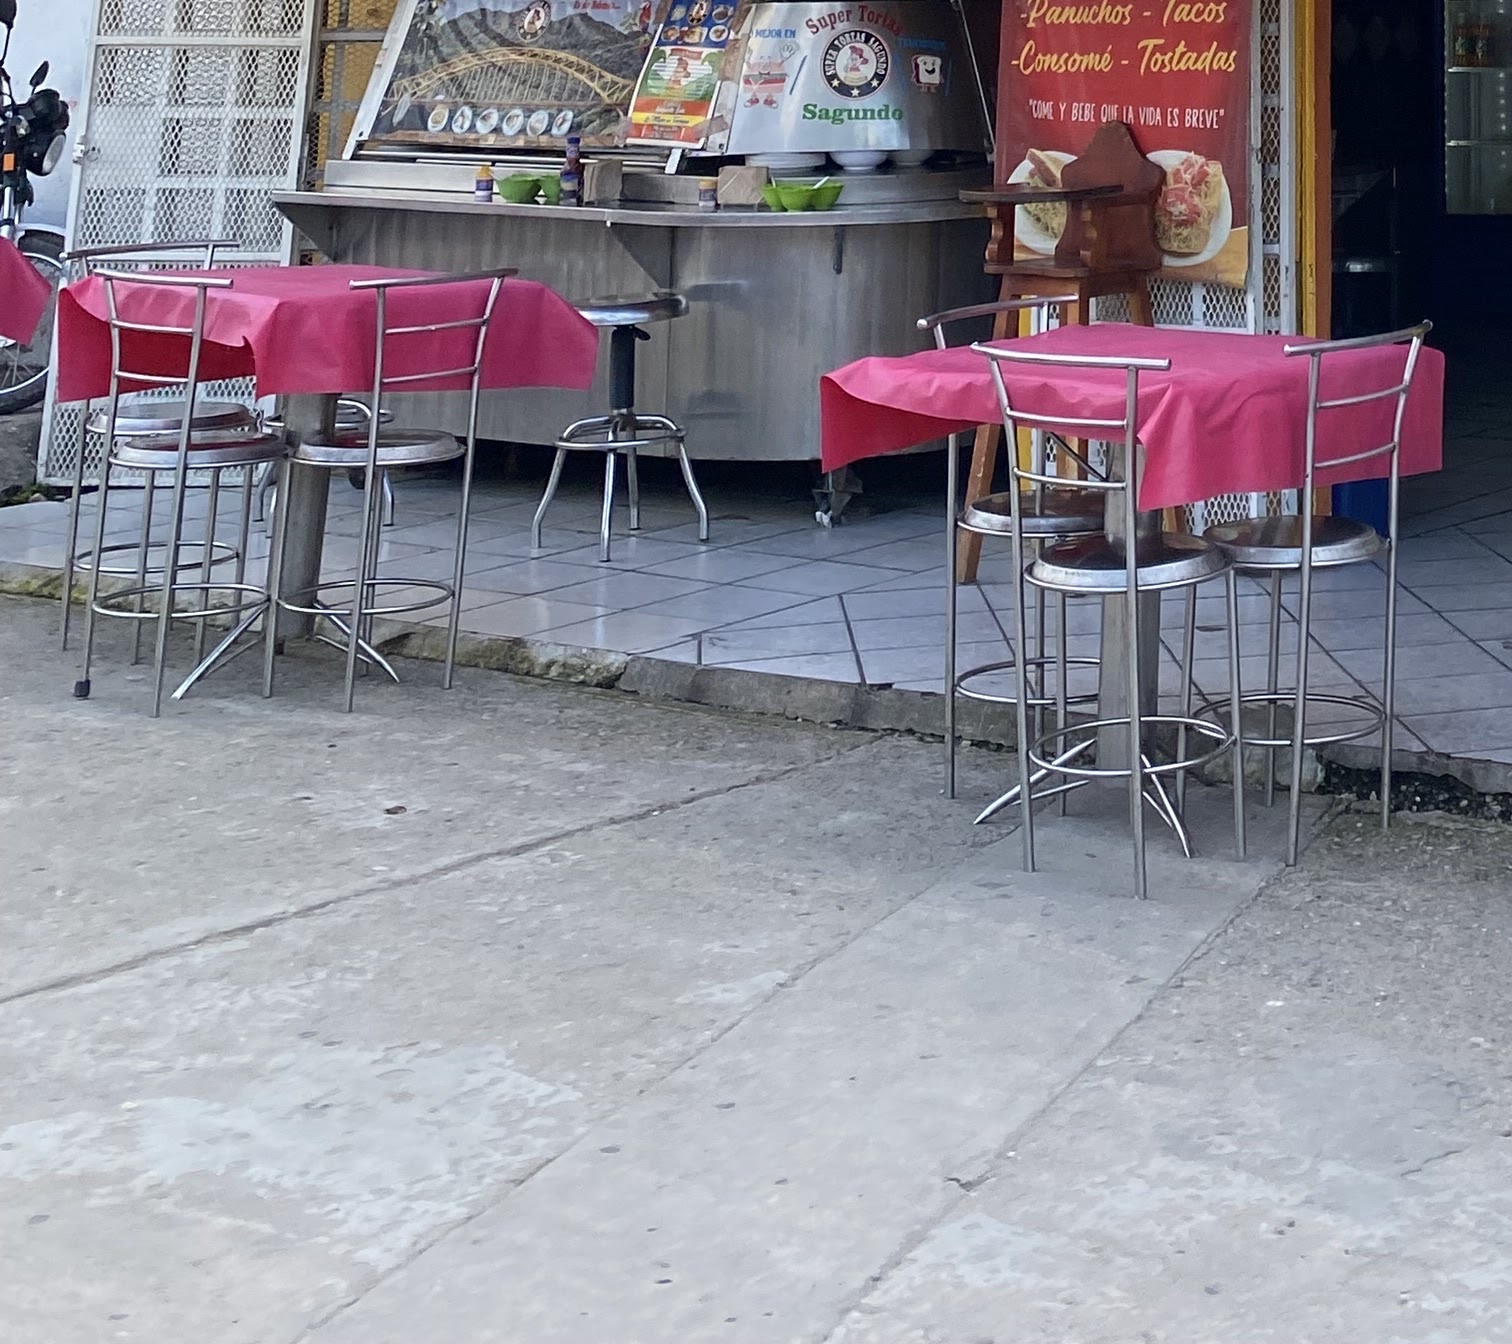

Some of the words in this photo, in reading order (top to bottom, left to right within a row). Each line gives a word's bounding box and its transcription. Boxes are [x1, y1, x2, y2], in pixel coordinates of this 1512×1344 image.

[755, 28, 782, 38] MEJOR
[805, 9, 852, 36] Super
[858, 4, 904, 37] Tortas
[835, 30, 867, 49] TORTAS
[869, 37, 888, 75] SAGUNDO
[1137, 38, 1238, 76] Tostadas
[802, 103, 904, 125] Sagundo
[1059, 101, 1067, 121] Y
[1071, 102, 1096, 122] BEBE
[1101, 104, 1119, 123] QUE
[1123, 105, 1134, 125] LA
[1139, 107, 1162, 127] VIDA
[1167, 107, 1179, 128] ES
